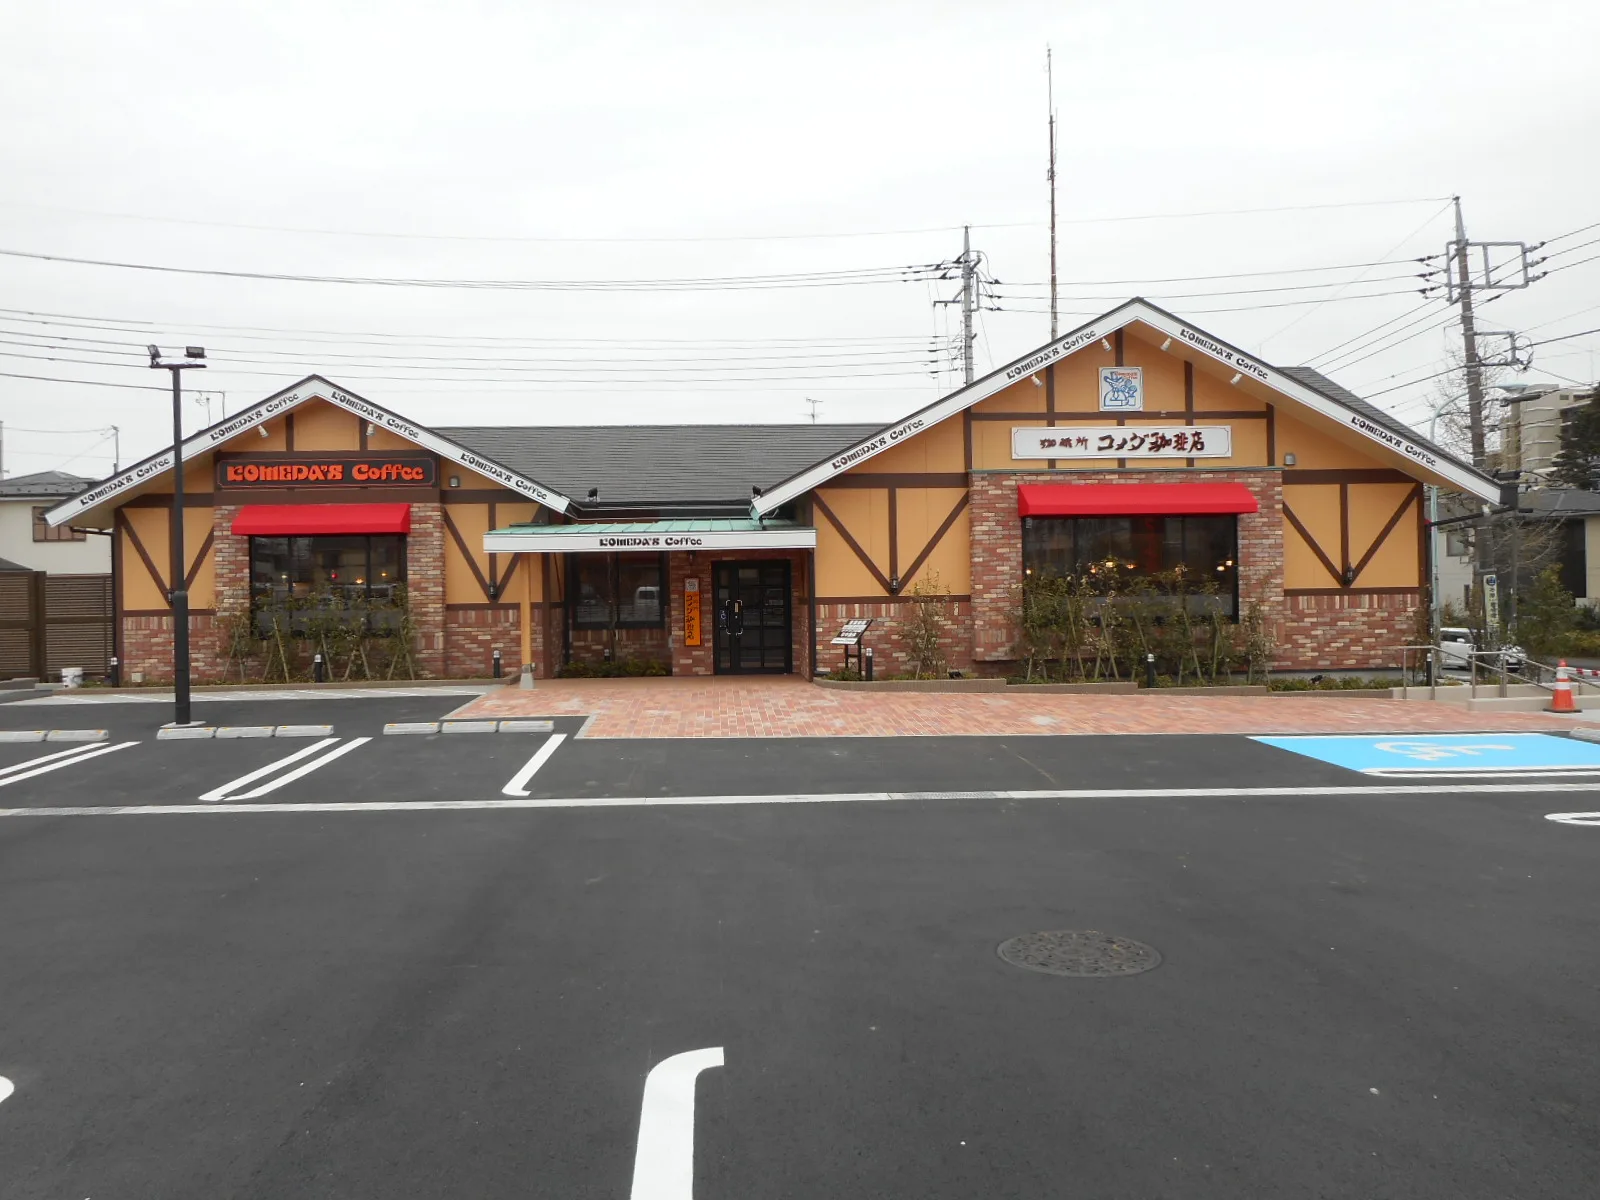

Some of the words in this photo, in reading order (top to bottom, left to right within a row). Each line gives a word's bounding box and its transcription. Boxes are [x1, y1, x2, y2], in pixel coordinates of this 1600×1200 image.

[1062, 329, 1096, 351] Coffee
[1236, 357, 1268, 380] Coffee
[266, 393, 299, 413] Coffee
[387, 417, 419, 439] Coffee
[890, 418, 924, 440] Coffee
[1097, 431, 1205, 453] コメダ珈琲店
[1405, 445, 1437, 467] Coffee
[136, 457, 170, 478] Coffee
[226, 464, 344, 481] KOMEDA'S
[352, 463, 424, 481] Coffee
[515, 479, 548, 500] Coffee
[599, 537, 660, 547] KOMEDA'S
[664, 536, 703, 547] Coffee
